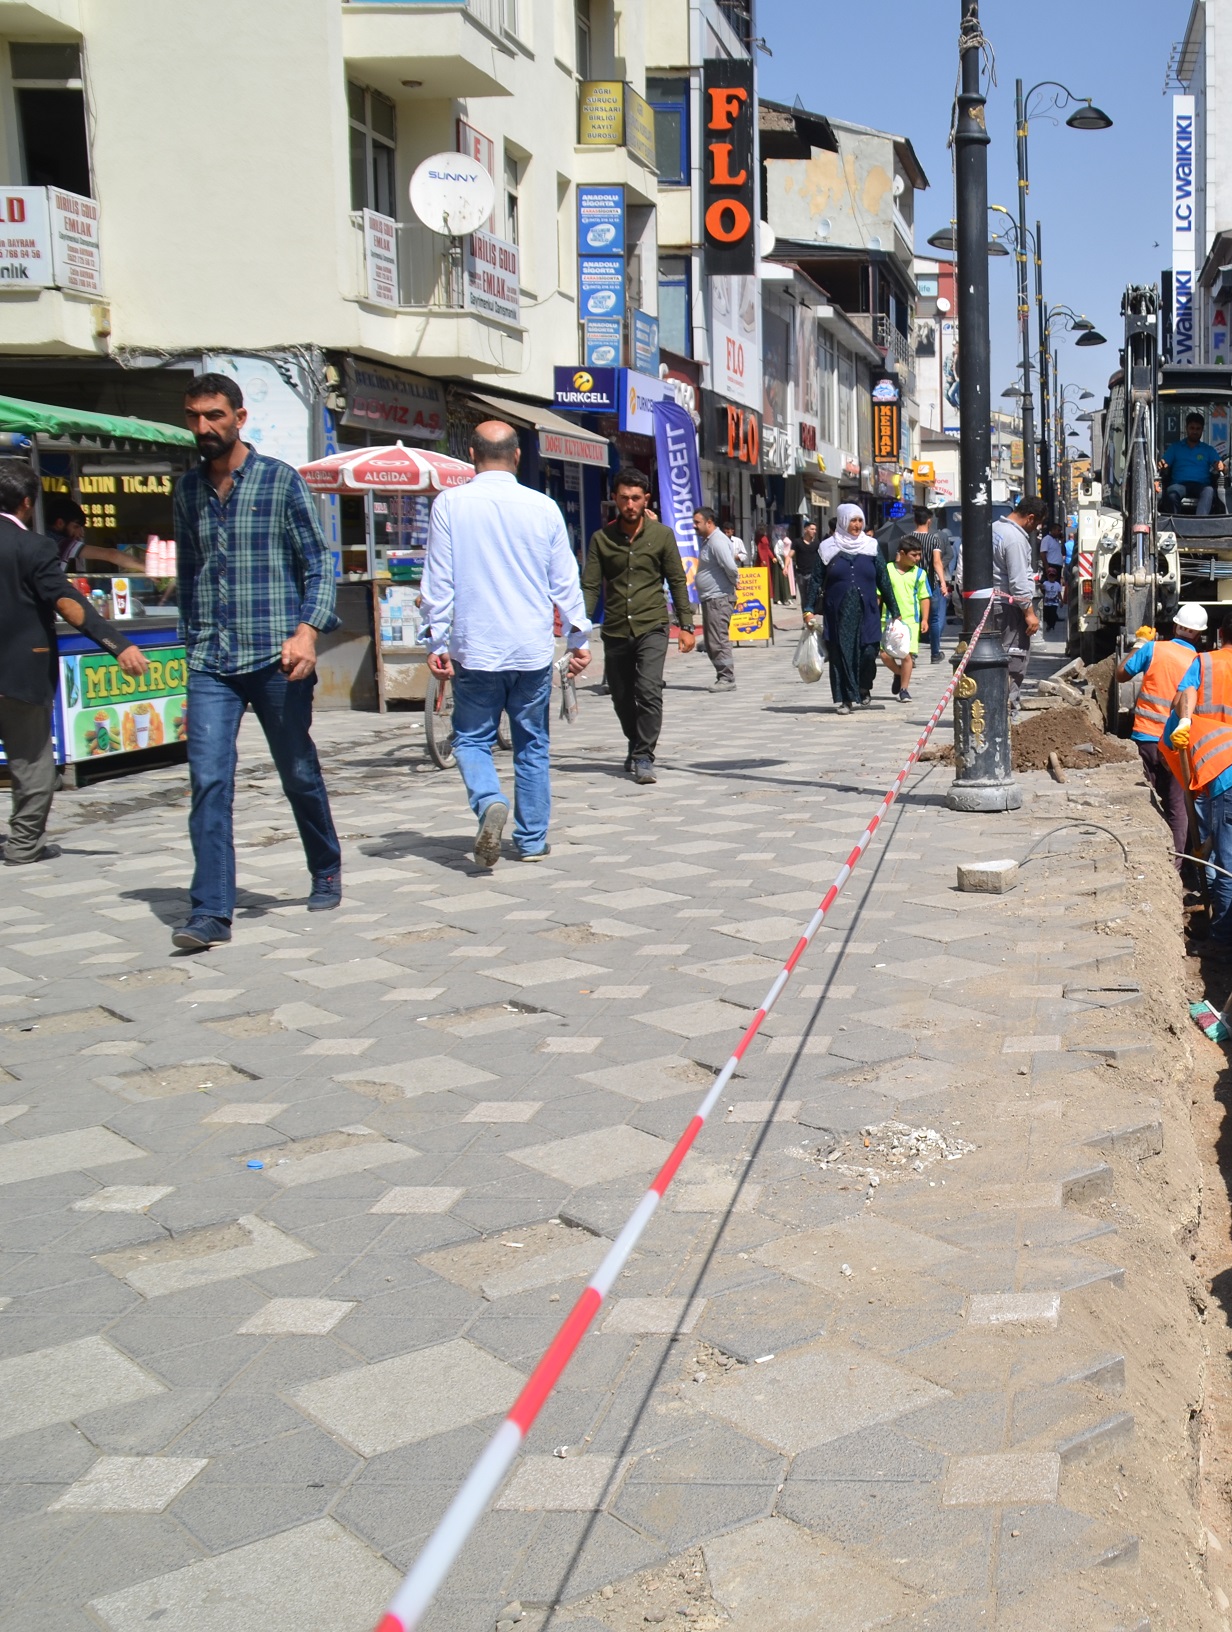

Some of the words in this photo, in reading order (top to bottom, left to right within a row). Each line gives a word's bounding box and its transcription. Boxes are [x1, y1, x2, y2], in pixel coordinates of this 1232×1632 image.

[428, 170, 478, 183] SUNNY
[705, 87, 751, 243] FLO
[64, 216, 92, 238] EMLAK
[1176, 204, 1192, 232] LC
[7, 238, 36, 248] BAYRAM
[499, 245, 517, 275] GOLD
[482, 270, 506, 300] EMLAK
[726, 336, 745, 378] FLO
[556, 391, 611, 404] TURKCELL
[636, 395, 655, 413] TURKCE
[727, 403, 759, 465] FLO
[880, 405, 892, 456] KEBAP
[93, 517, 103, 528] 23
